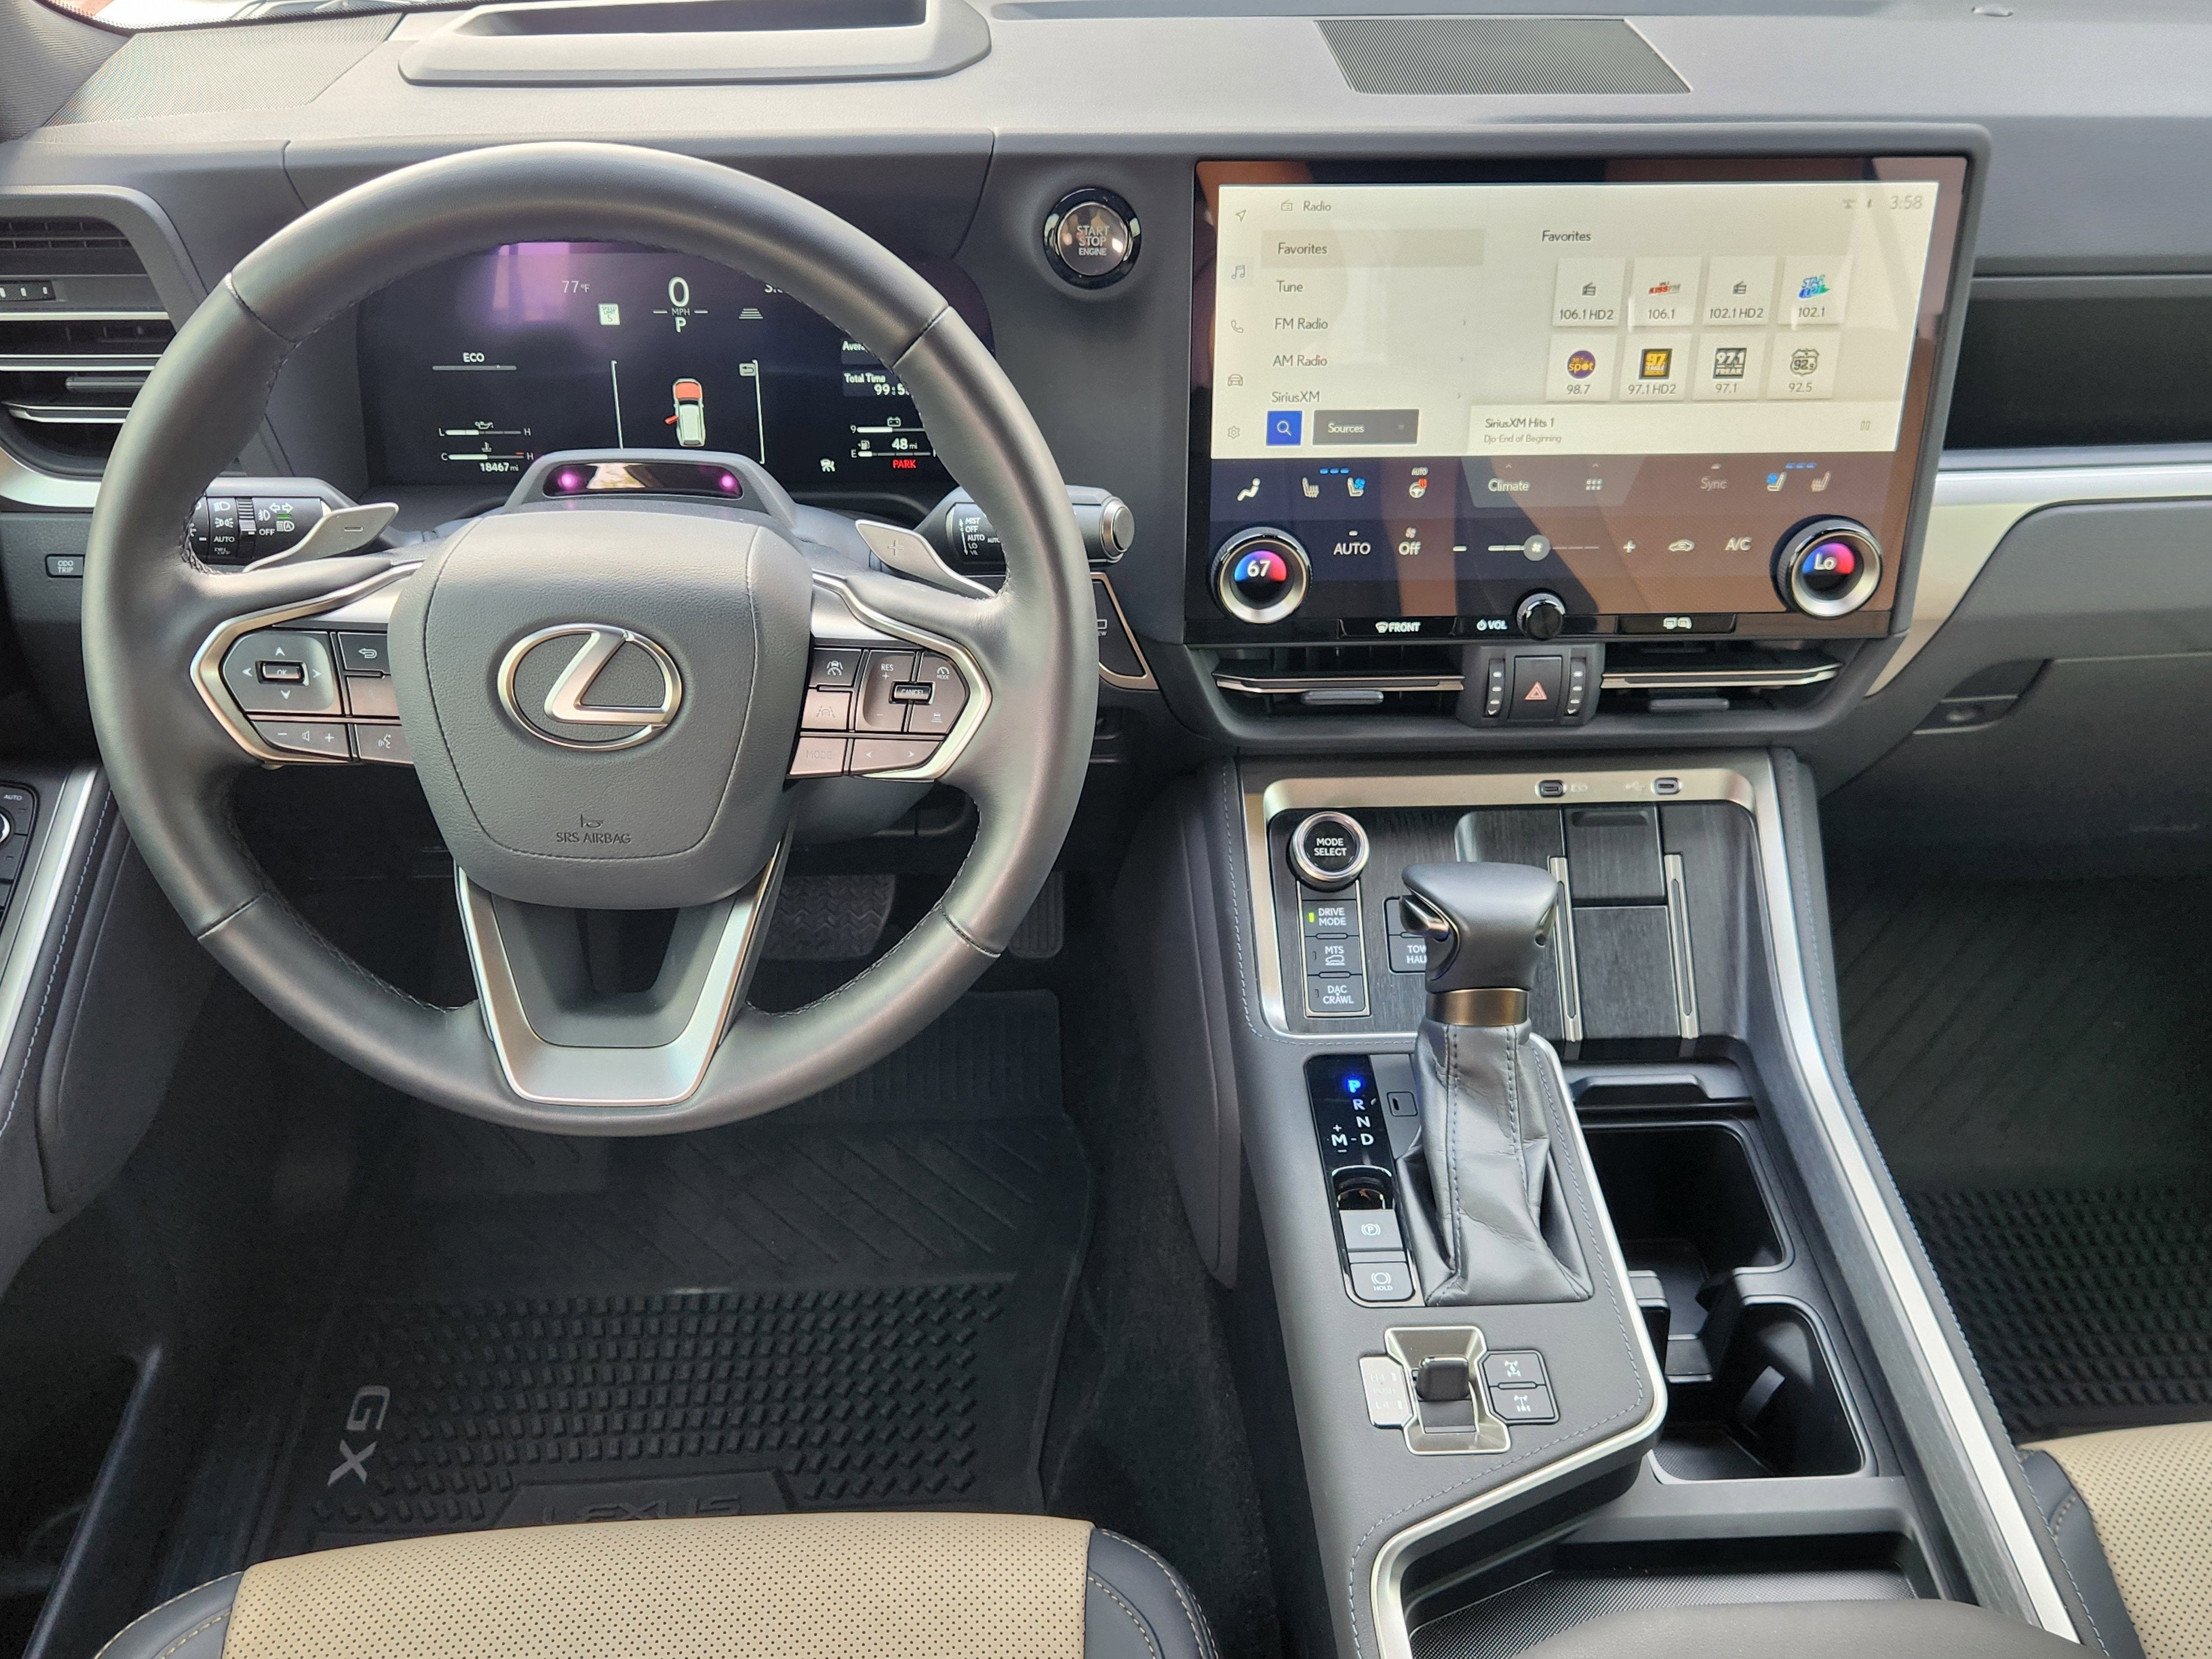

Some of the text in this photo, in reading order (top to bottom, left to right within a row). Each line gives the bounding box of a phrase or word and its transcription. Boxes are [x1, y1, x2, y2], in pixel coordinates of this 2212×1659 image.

[1302, 201, 1332, 212] Radio
[1890, 196, 1922, 210] 3:58
[1077, 226, 1110, 236] START
[1542, 230, 1592, 242] Favorites
[1079, 236, 1107, 246] STOP
[1078, 247, 1107, 255] ENGINE
[1277, 242, 1327, 255] Favorites
[668, 276, 690, 307] 0
[1276, 281, 1303, 293] Tune
[1559, 309, 1614, 320] 106.1 HD2
[1648, 309, 1675, 320] 106.1
[1709, 307, 1764, 319] 102.1 HD2
[1798, 306, 1825, 317] 102.1
[675, 317, 686, 332] P
[1274, 318, 1328, 330] FM Radio
[463, 353, 484, 362] ECO
[1272, 356, 1328, 367] AM Radio
[1717, 352, 1745, 364] 97.1
[844, 373, 886, 383] Total Time
[1566, 384, 1591, 394] 98.7
[1628, 384, 1676, 394] 97.1 HD2
[1715, 384, 1737, 393] 97.1
[1788, 383, 1813, 393] 92.5
[1271, 392, 1320, 403] SiriusXM
[1328, 423, 1364, 434] Sources
[1485, 419, 1526, 429] SiriusXM
[1528, 418, 1547, 428] Hits
[439, 427, 445, 436] L
[524, 427, 531, 436] H
[891, 438, 908, 450] 48
[1499, 435, 1514, 443] End
[1515, 435, 1525, 443] of
[1525, 435, 1562, 444] Beginning
[441, 452, 448, 461] C
[851, 450, 857, 458] E
[480, 462, 509, 472] 18467
[893, 460, 916, 468] PARK
[1488, 480, 1529, 492] Climate
[1700, 477, 1728, 491] Sync
[1333, 542, 1371, 555] AUTO
[1399, 542, 1421, 556] Off
[1725, 538, 1752, 551] A/C
[1813, 554, 1837, 570] Lo
[1247, 560, 1271, 577] 67
[1389, 622, 1421, 633] FRONT
[1488, 620, 1507, 630] VOL
[805, 749, 833, 760] MODE
[556, 832, 632, 844] SRS AIRBAG
[1316, 838, 1344, 847] MODE
[1313, 848, 1347, 857] SELECT
[1318, 907, 1345, 916] DRIVE
[1318, 917, 1347, 926] MODE
[1324, 946, 1344, 954] MTS
[1407, 945, 1427, 954] TOW
[1406, 954, 1427, 964] HAU
[1327, 985, 1348, 994] DAC
[1323, 994, 1355, 1004] CRAWL
[1348, 1080, 1361, 1093] P
[1352, 1098, 1366, 1111] R
[1355, 1115, 1371, 1128] N
[1360, 1133, 1375, 1146] D
